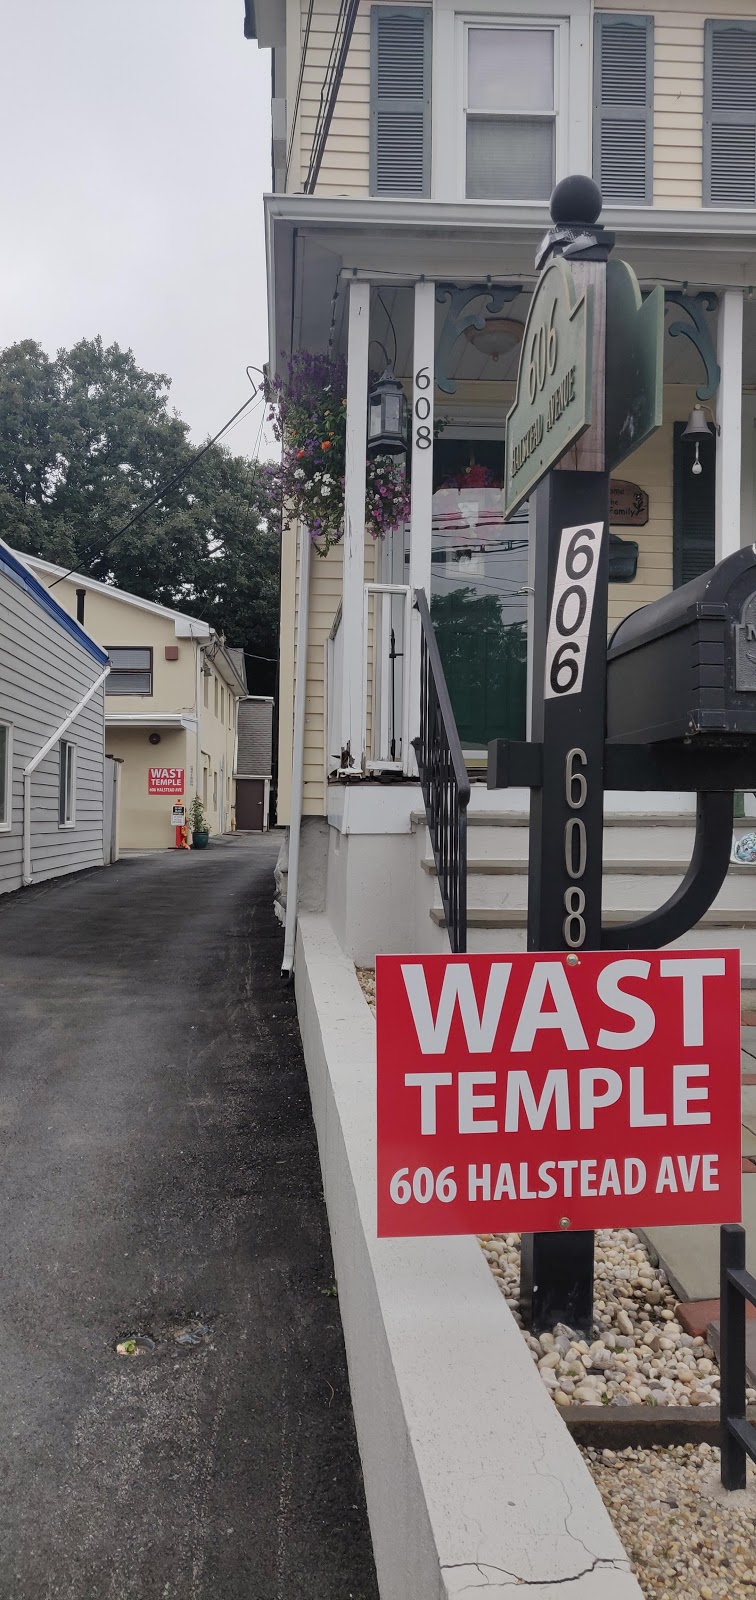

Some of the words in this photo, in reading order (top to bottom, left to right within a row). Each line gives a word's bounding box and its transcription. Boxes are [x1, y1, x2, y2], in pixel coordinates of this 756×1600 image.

[527, 297, 559, 406] 606
[415, 366, 432, 450] 608
[545, 364, 578, 434] AVENUE
[549, 527, 597, 695] 606
[151, 768, 183, 778] WAST
[562, 747, 588, 949] 608
[400, 957, 726, 1055] WAST
[404, 1063, 711, 1136] TEMPLE
[389, 1165, 458, 1205] 606
[467, 1157, 647, 1202] HALSTEAD
[655, 1154, 720, 1194] AVE
